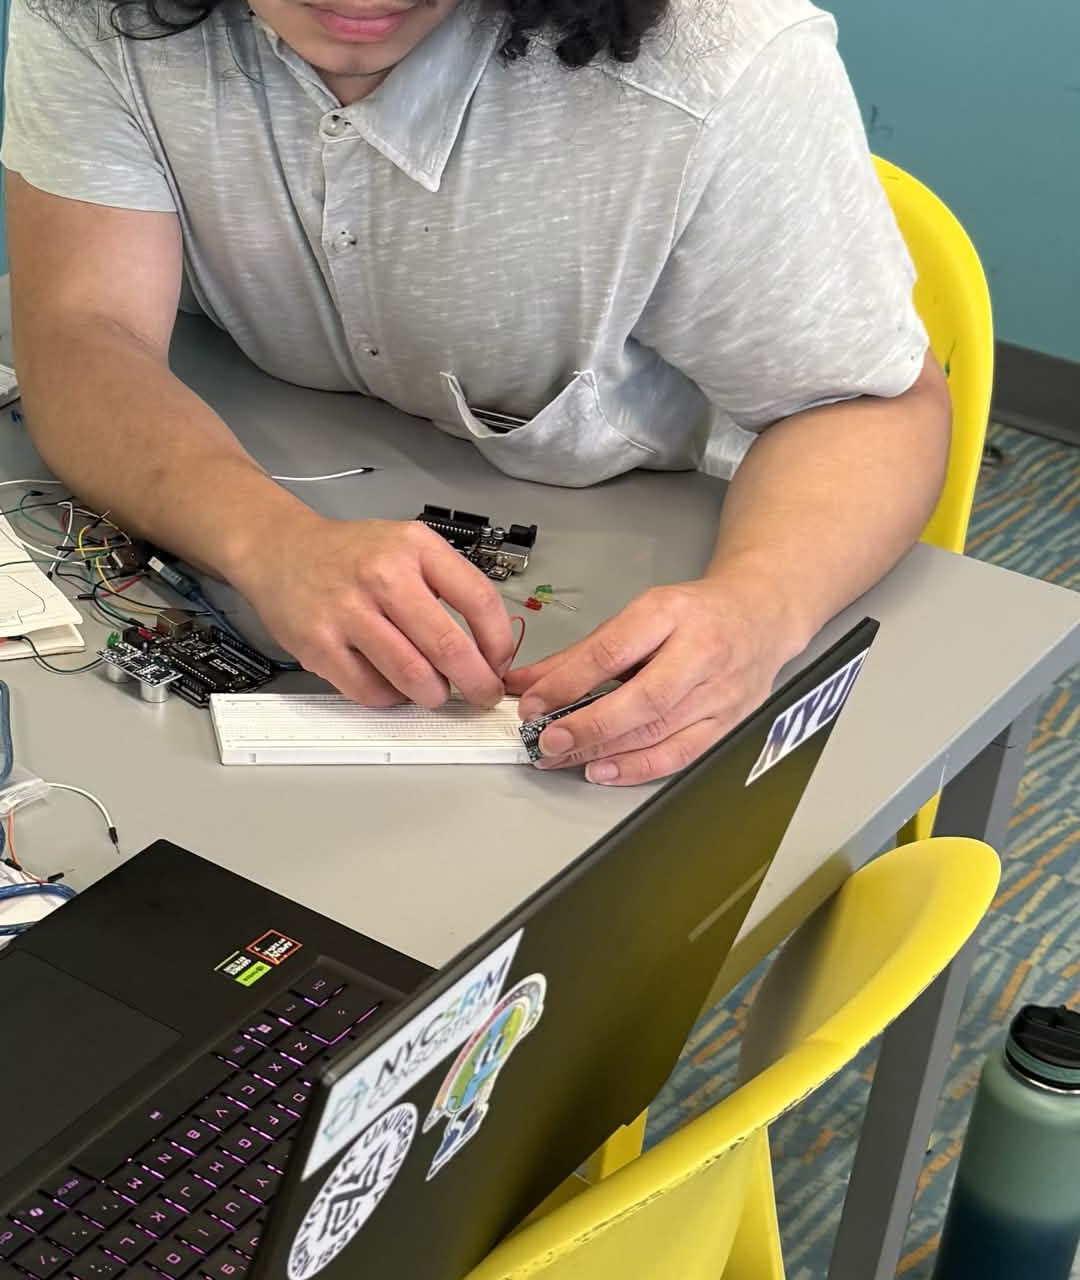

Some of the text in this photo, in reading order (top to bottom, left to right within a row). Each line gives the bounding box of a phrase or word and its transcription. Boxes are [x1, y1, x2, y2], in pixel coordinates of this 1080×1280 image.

[751, 656, 865, 778] NYU
[373, 956, 509, 1089] NYCSRM
[294, 1042, 308, 1051] Z
[268, 1063, 282, 1072] X
[241, 1084, 256, 1095] C
[215, 1109, 229, 1118] V
[269, 1115, 280, 1125] F
[186, 1129, 201, 1140] B
[238, 1138, 252, 1149] G
[157, 1153, 173, 1164] N
[209, 1161, 225, 1173] H
[127, 1177, 143, 1189] M
[179, 1186, 191, 1198] J
[150, 1211, 166, 1222] K
[119, 1237, 136, 1245] L
